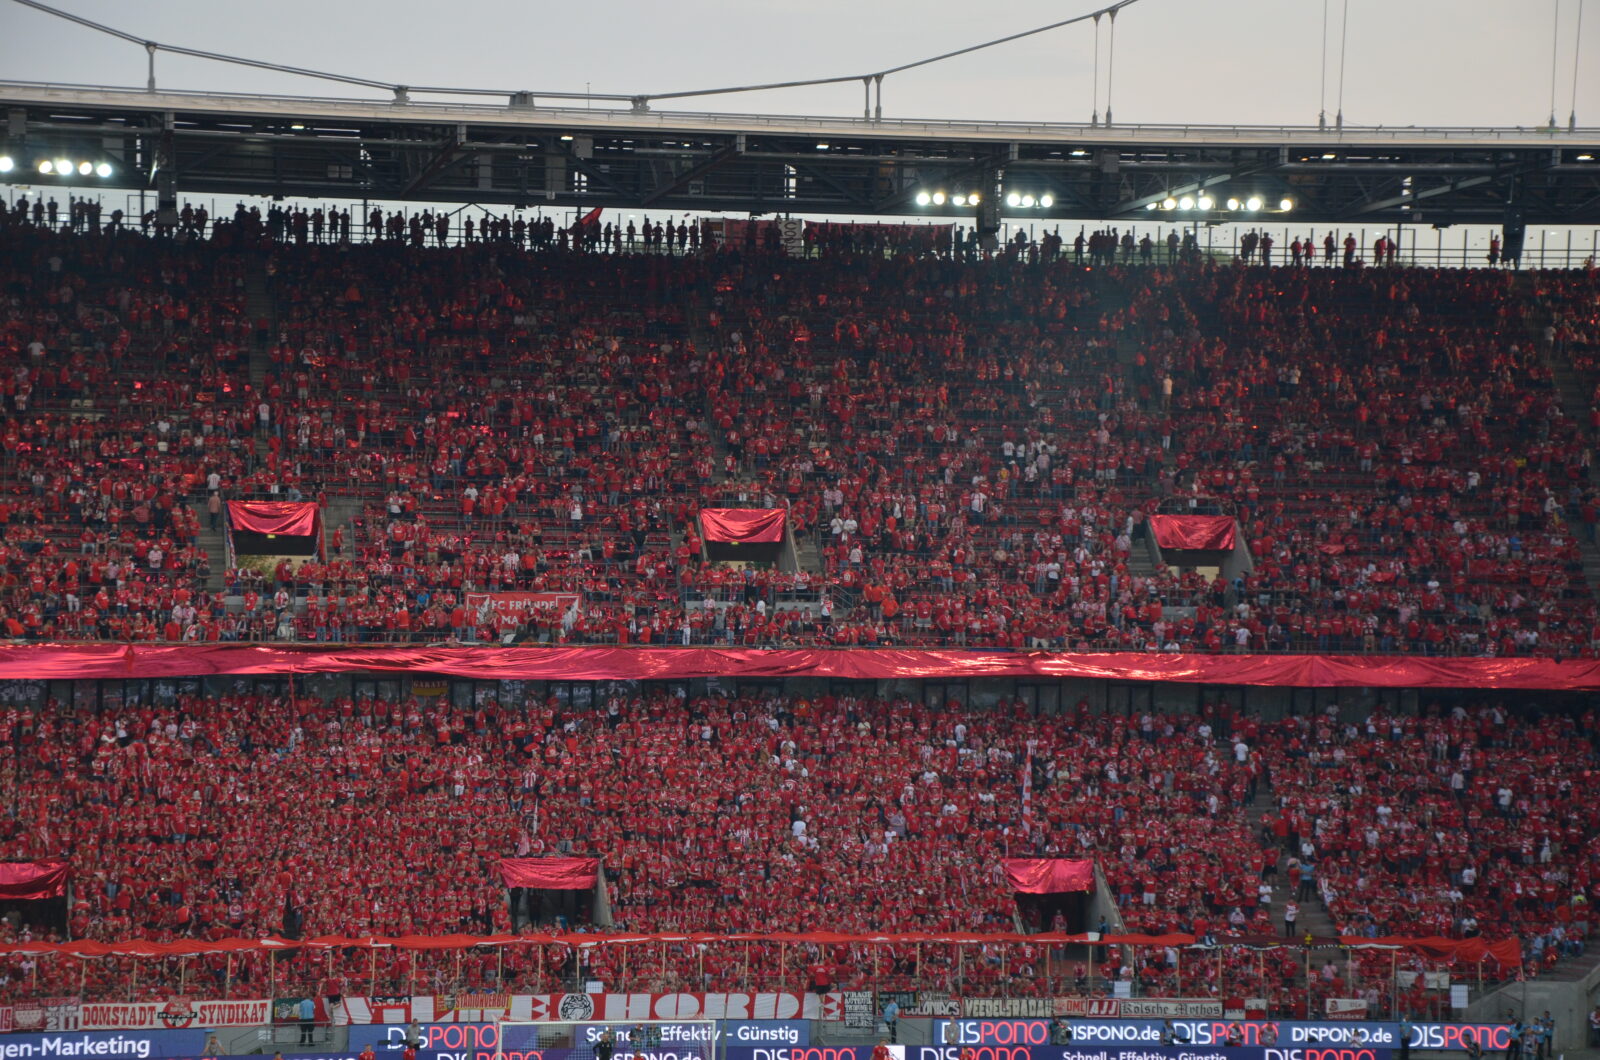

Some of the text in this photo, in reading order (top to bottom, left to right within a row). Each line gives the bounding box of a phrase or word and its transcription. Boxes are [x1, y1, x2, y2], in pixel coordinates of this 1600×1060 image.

[492, 600, 505, 610] FC
[455, 993, 510, 1009] STADIONVERBOT
[604, 992, 842, 1021] HORDE
[82, 1005, 157, 1027] DOMSTADT
[198, 1002, 268, 1025] SYNDIKAT
[387, 1024, 499, 1049] DPONO
[660, 1025, 721, 1041] Effektiv
[737, 1025, 799, 1044] Günstig
[1070, 1024, 1160, 1041] ISPONO.de
[1291, 1026, 1393, 1043] DISPONO.de
